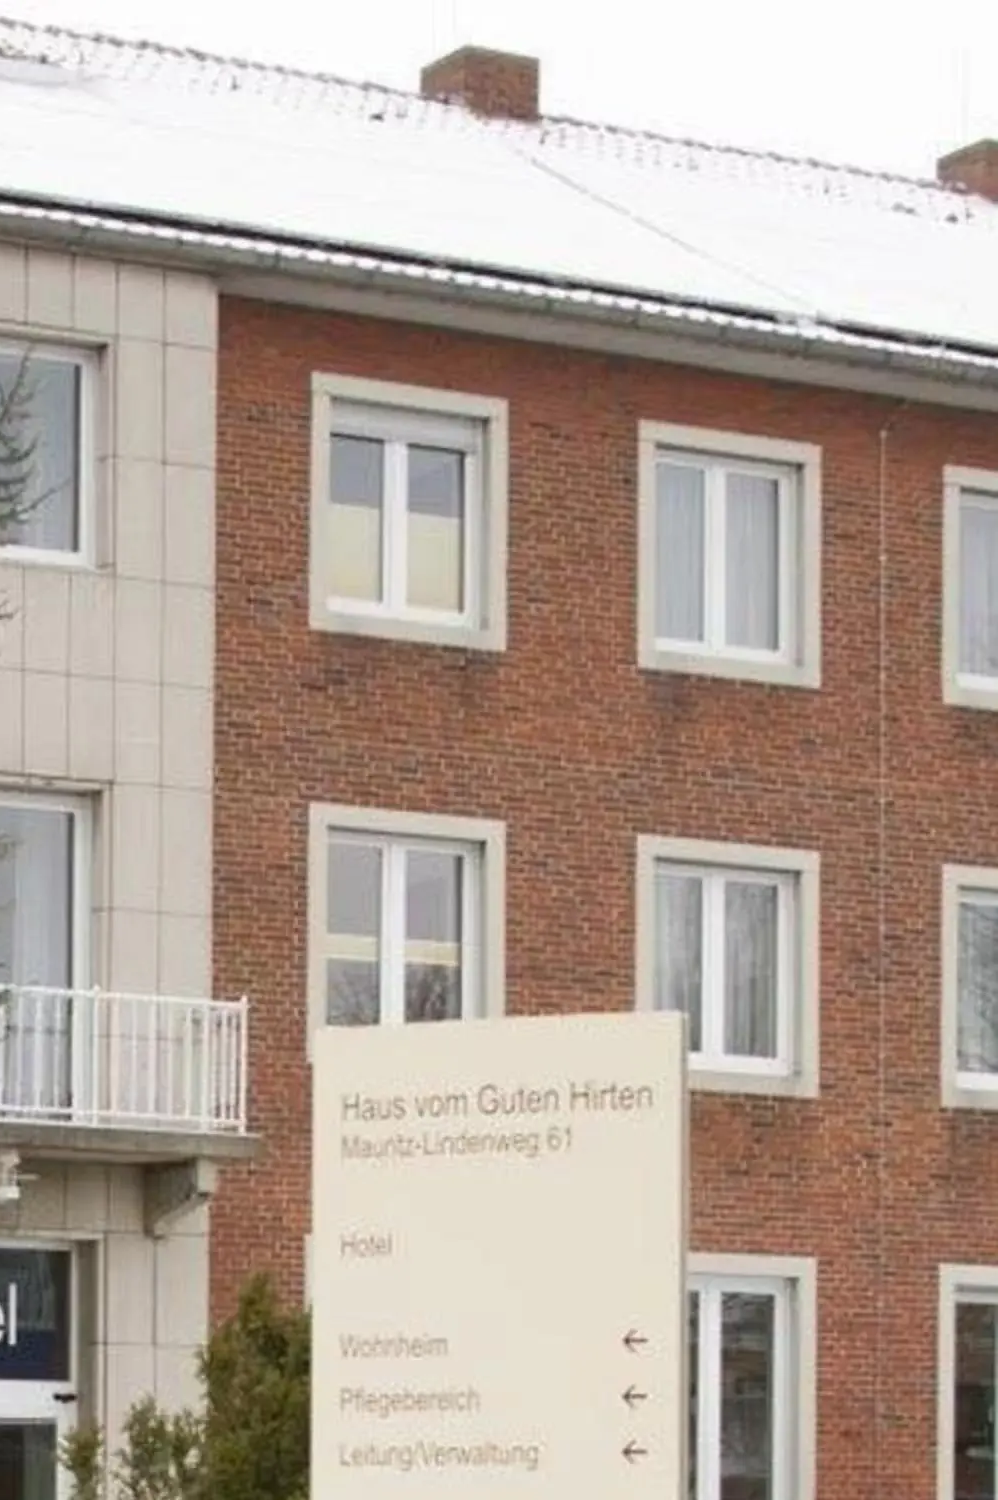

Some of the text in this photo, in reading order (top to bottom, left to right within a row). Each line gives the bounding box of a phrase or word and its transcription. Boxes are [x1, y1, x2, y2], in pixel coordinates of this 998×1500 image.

[342, 1081, 654, 1121] Haus vom Guten Hirten
[547, 1127, 573, 1151] 61
[340, 1233, 393, 1258] Hotel
[339, 1333, 449, 1358] Wohnheim
[339, 1387, 481, 1418] Pflegebereich
[339, 1443, 539, 1471] Leitung/Verwaltung
